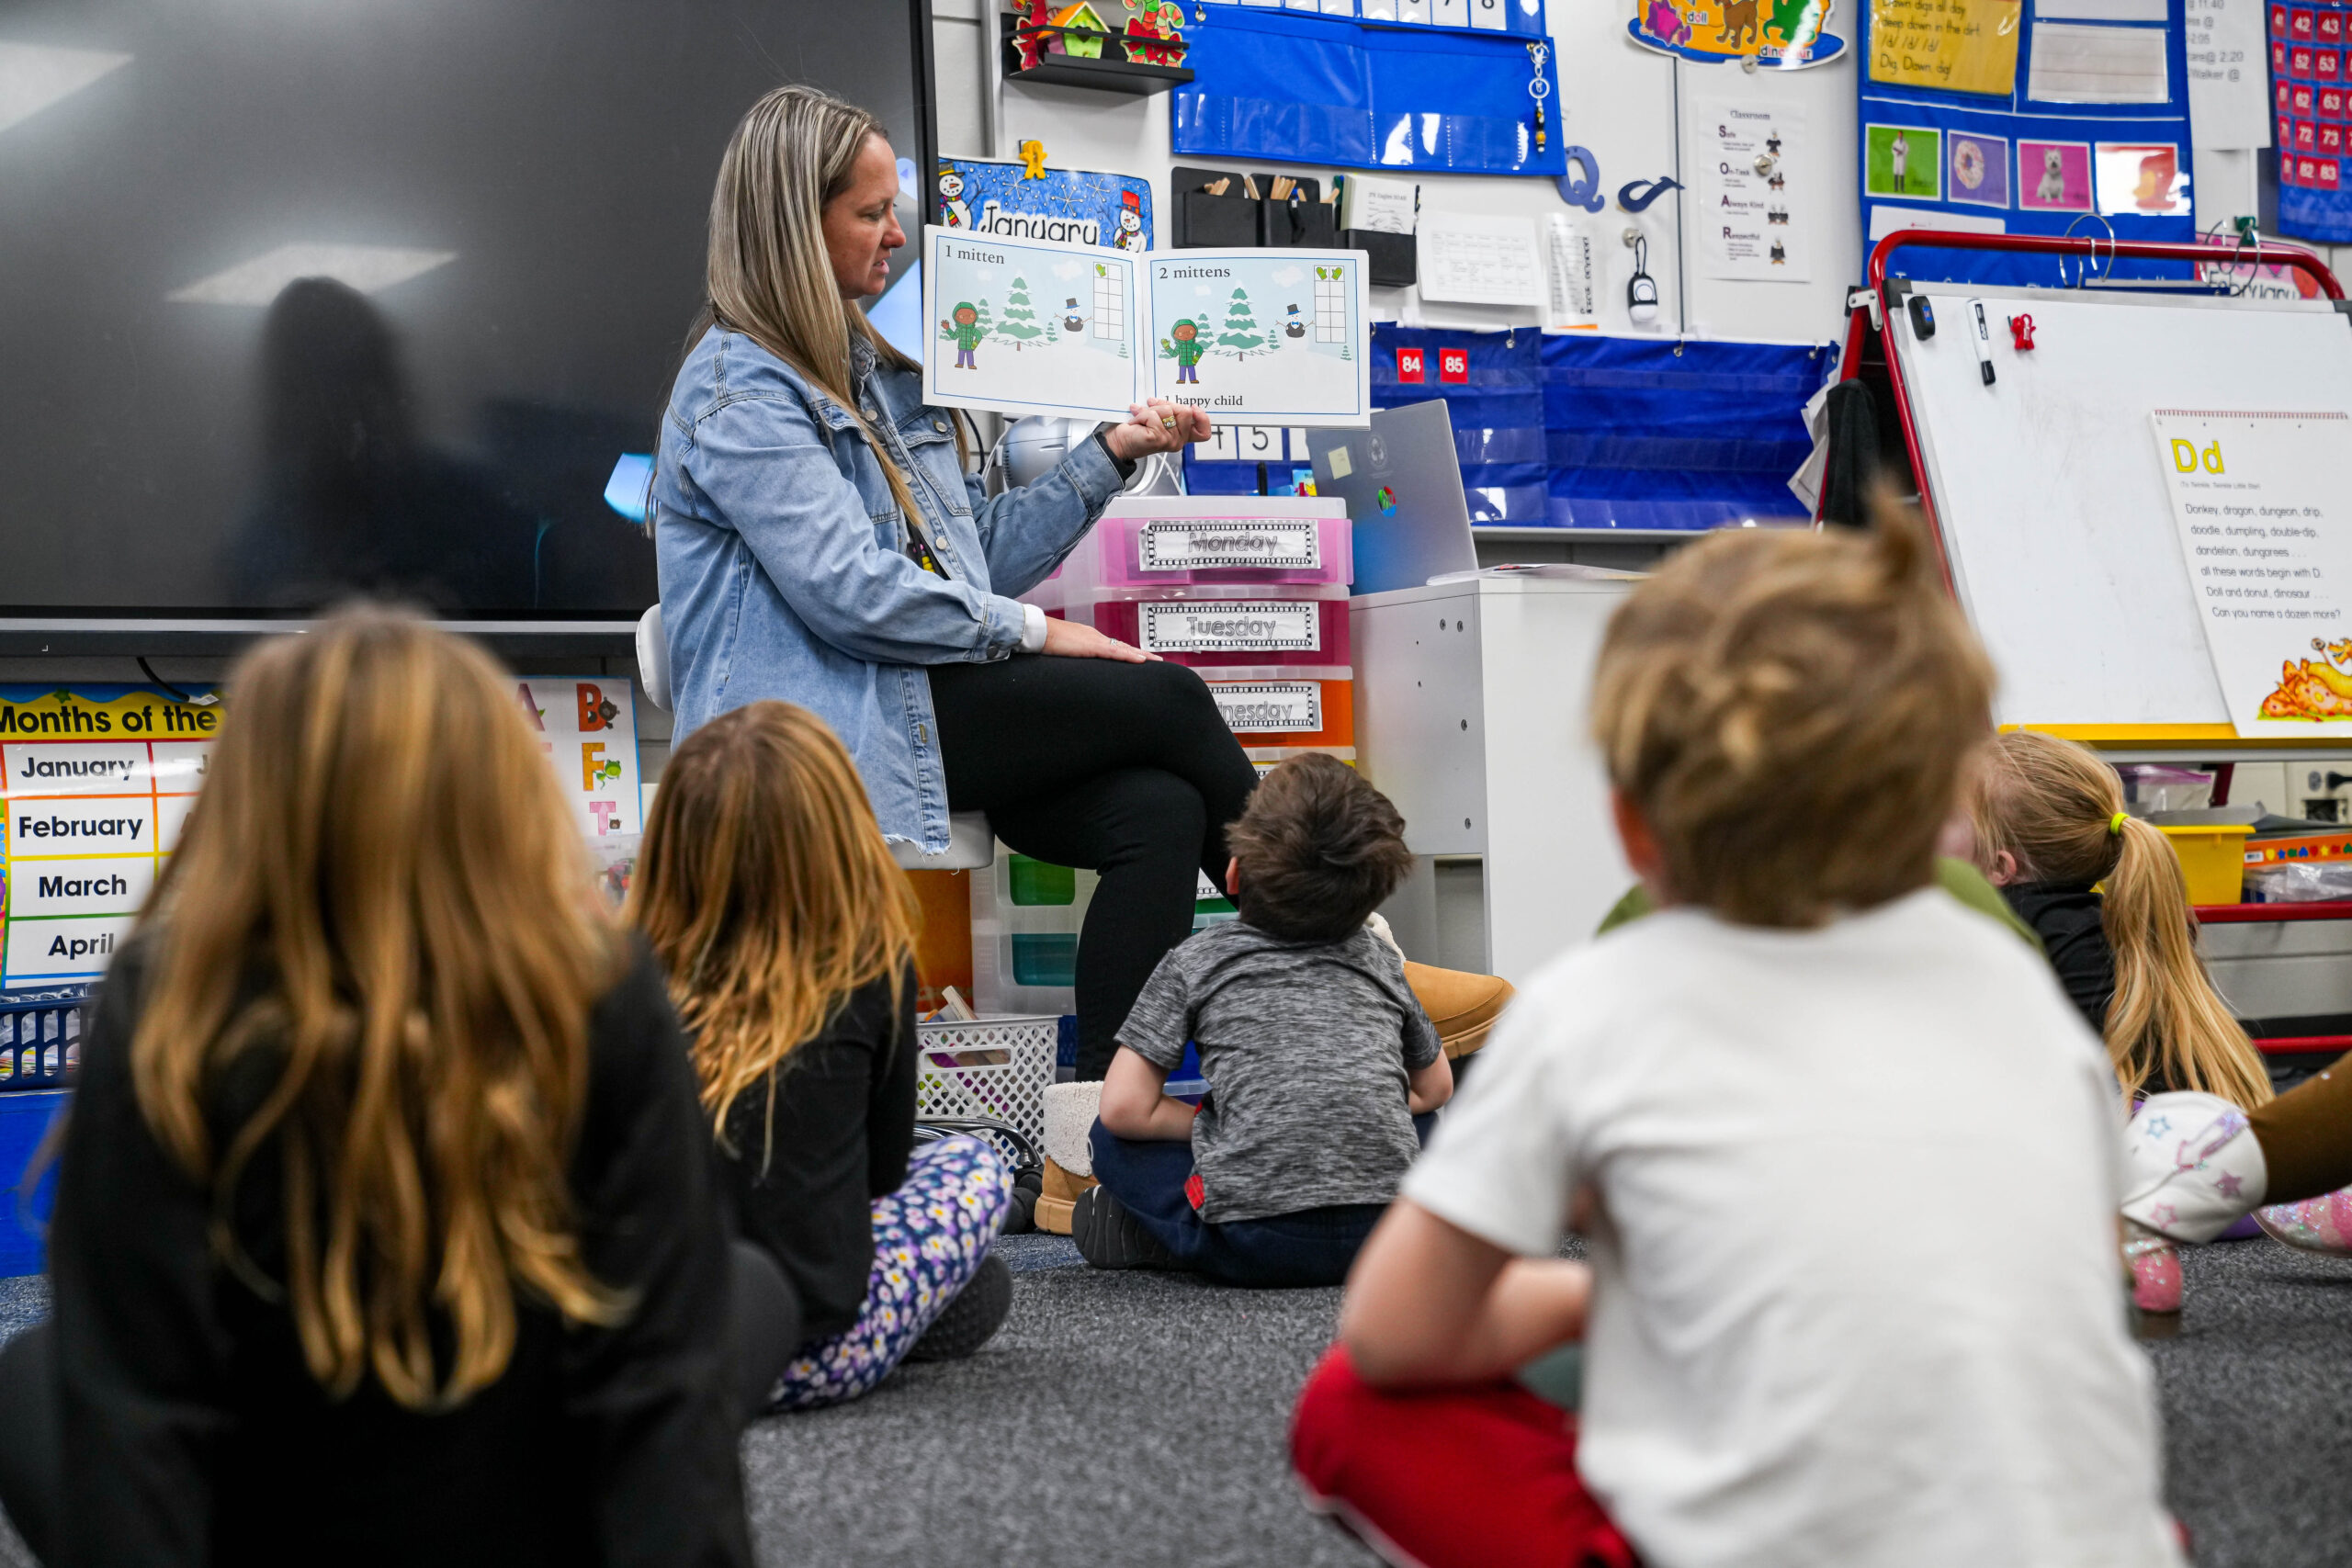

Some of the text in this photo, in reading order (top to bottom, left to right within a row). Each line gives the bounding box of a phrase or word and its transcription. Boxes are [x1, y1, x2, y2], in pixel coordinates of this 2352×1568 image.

[1688, 11, 1706, 23] doll
[2295, 17, 2310, 32] 42
[2322, 18, 2339, 34] 43
[1761, 46, 1811, 59] dinour
[2294, 53, 2310, 70] 52
[2319, 55, 2336, 72] 53
[2324, 94, 2340, 110] 63
[2299, 126, 2312, 142] 72
[2323, 130, 2339, 146] 73
[945, 245, 1004, 265] 1 mitten
[1159, 265, 1230, 279] 2 mittens
[1402, 355, 1464, 373] 84 85
[1175, 395, 1211, 408] happy
[1214, 395, 1243, 406] child
[1189, 532, 1278, 556] Monday
[2243, 547, 2290, 559] dungarees
[2200, 567, 2211, 577] all
[2213, 567, 2236, 577] these
[2240, 568, 2266, 578] words
[2267, 568, 2291, 580] begin
[2293, 568, 2311, 578] with
[2206, 587, 2223, 596] Doll
[2225, 588, 2242, 597] and
[2274, 588, 2311, 598] dinosaur
[2212, 607, 2341, 620] Can you name a dozen more?
[1187, 616, 1277, 639] Tuesday
[576, 683, 607, 732] B
[121, 705, 153, 732] of
[163, 705, 218, 731] the
[20, 757, 134, 781] January
[581, 742, 605, 791] F
[18, 816, 143, 840] February
[589, 801, 616, 836] T
[39, 874, 127, 897] March
[48, 933, 115, 960] April
